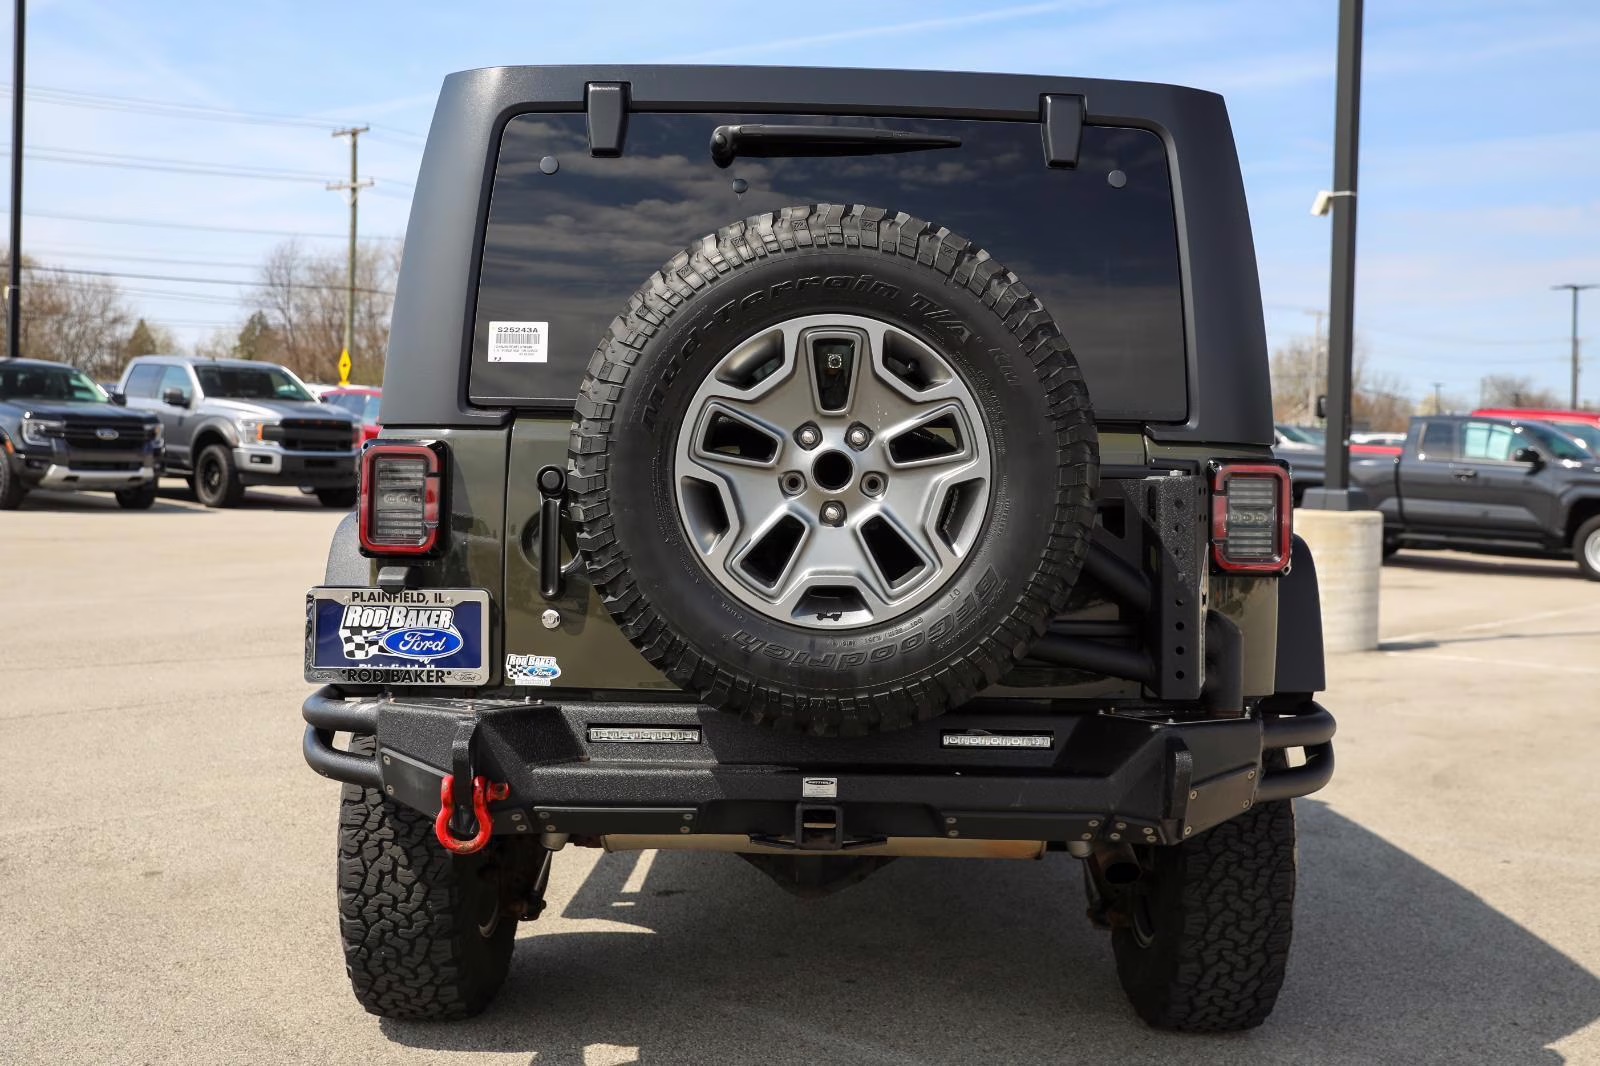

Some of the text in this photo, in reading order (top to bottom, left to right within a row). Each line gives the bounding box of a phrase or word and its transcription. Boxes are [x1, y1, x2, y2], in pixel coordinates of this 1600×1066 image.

[351, 592, 445, 606] PLAINFIELD, IL
[344, 605, 453, 629] ROD BAKER
[398, 631, 447, 652] Ford
[347, 670, 446, 684] ROD BAKER
